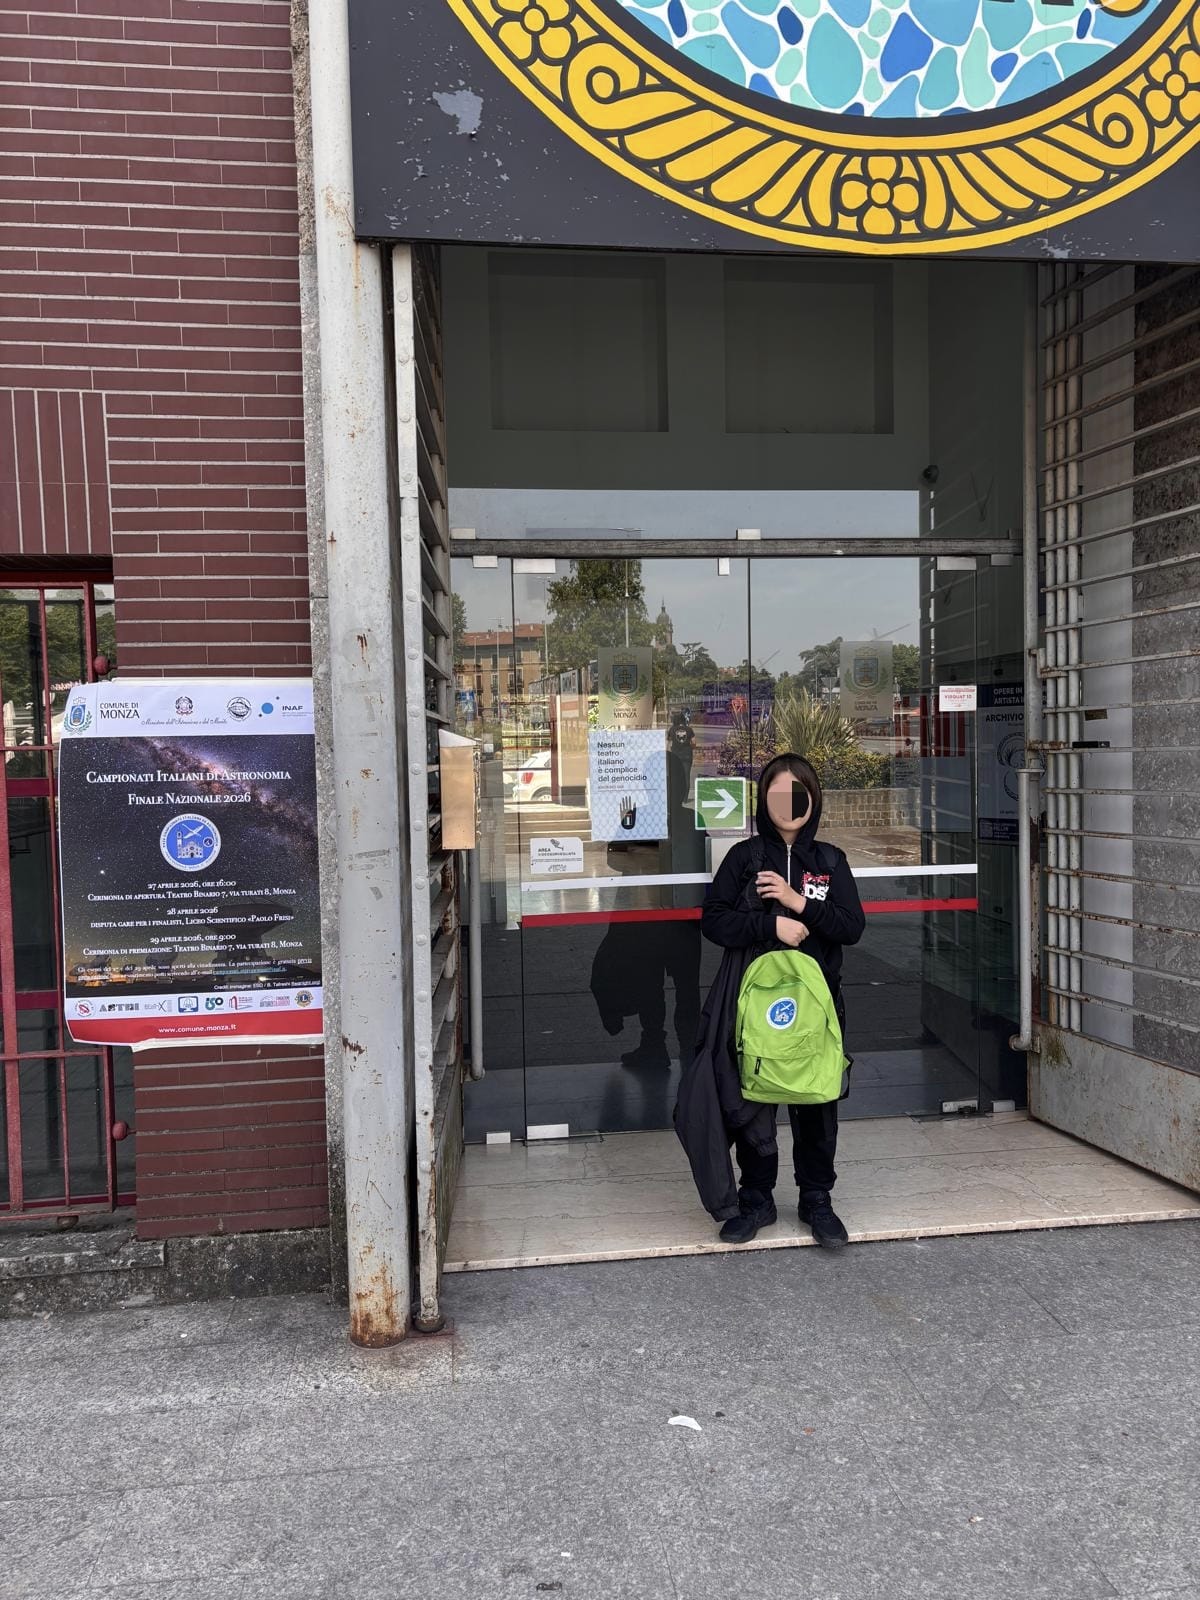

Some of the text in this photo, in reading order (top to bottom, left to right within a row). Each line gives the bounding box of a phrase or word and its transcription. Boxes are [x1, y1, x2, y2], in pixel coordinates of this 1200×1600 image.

[100, 709, 140, 719] MONZA
[611, 774, 647, 783] genocidio
[223, 791, 251, 803] 2026
[217, 879, 237, 887] 16:00
[167, 907, 176, 916] 28
[200, 906, 219, 914] 2026
[219, 934, 236, 942] 9:00
[158, 1023, 237, 1033] www.comune.monza.it
